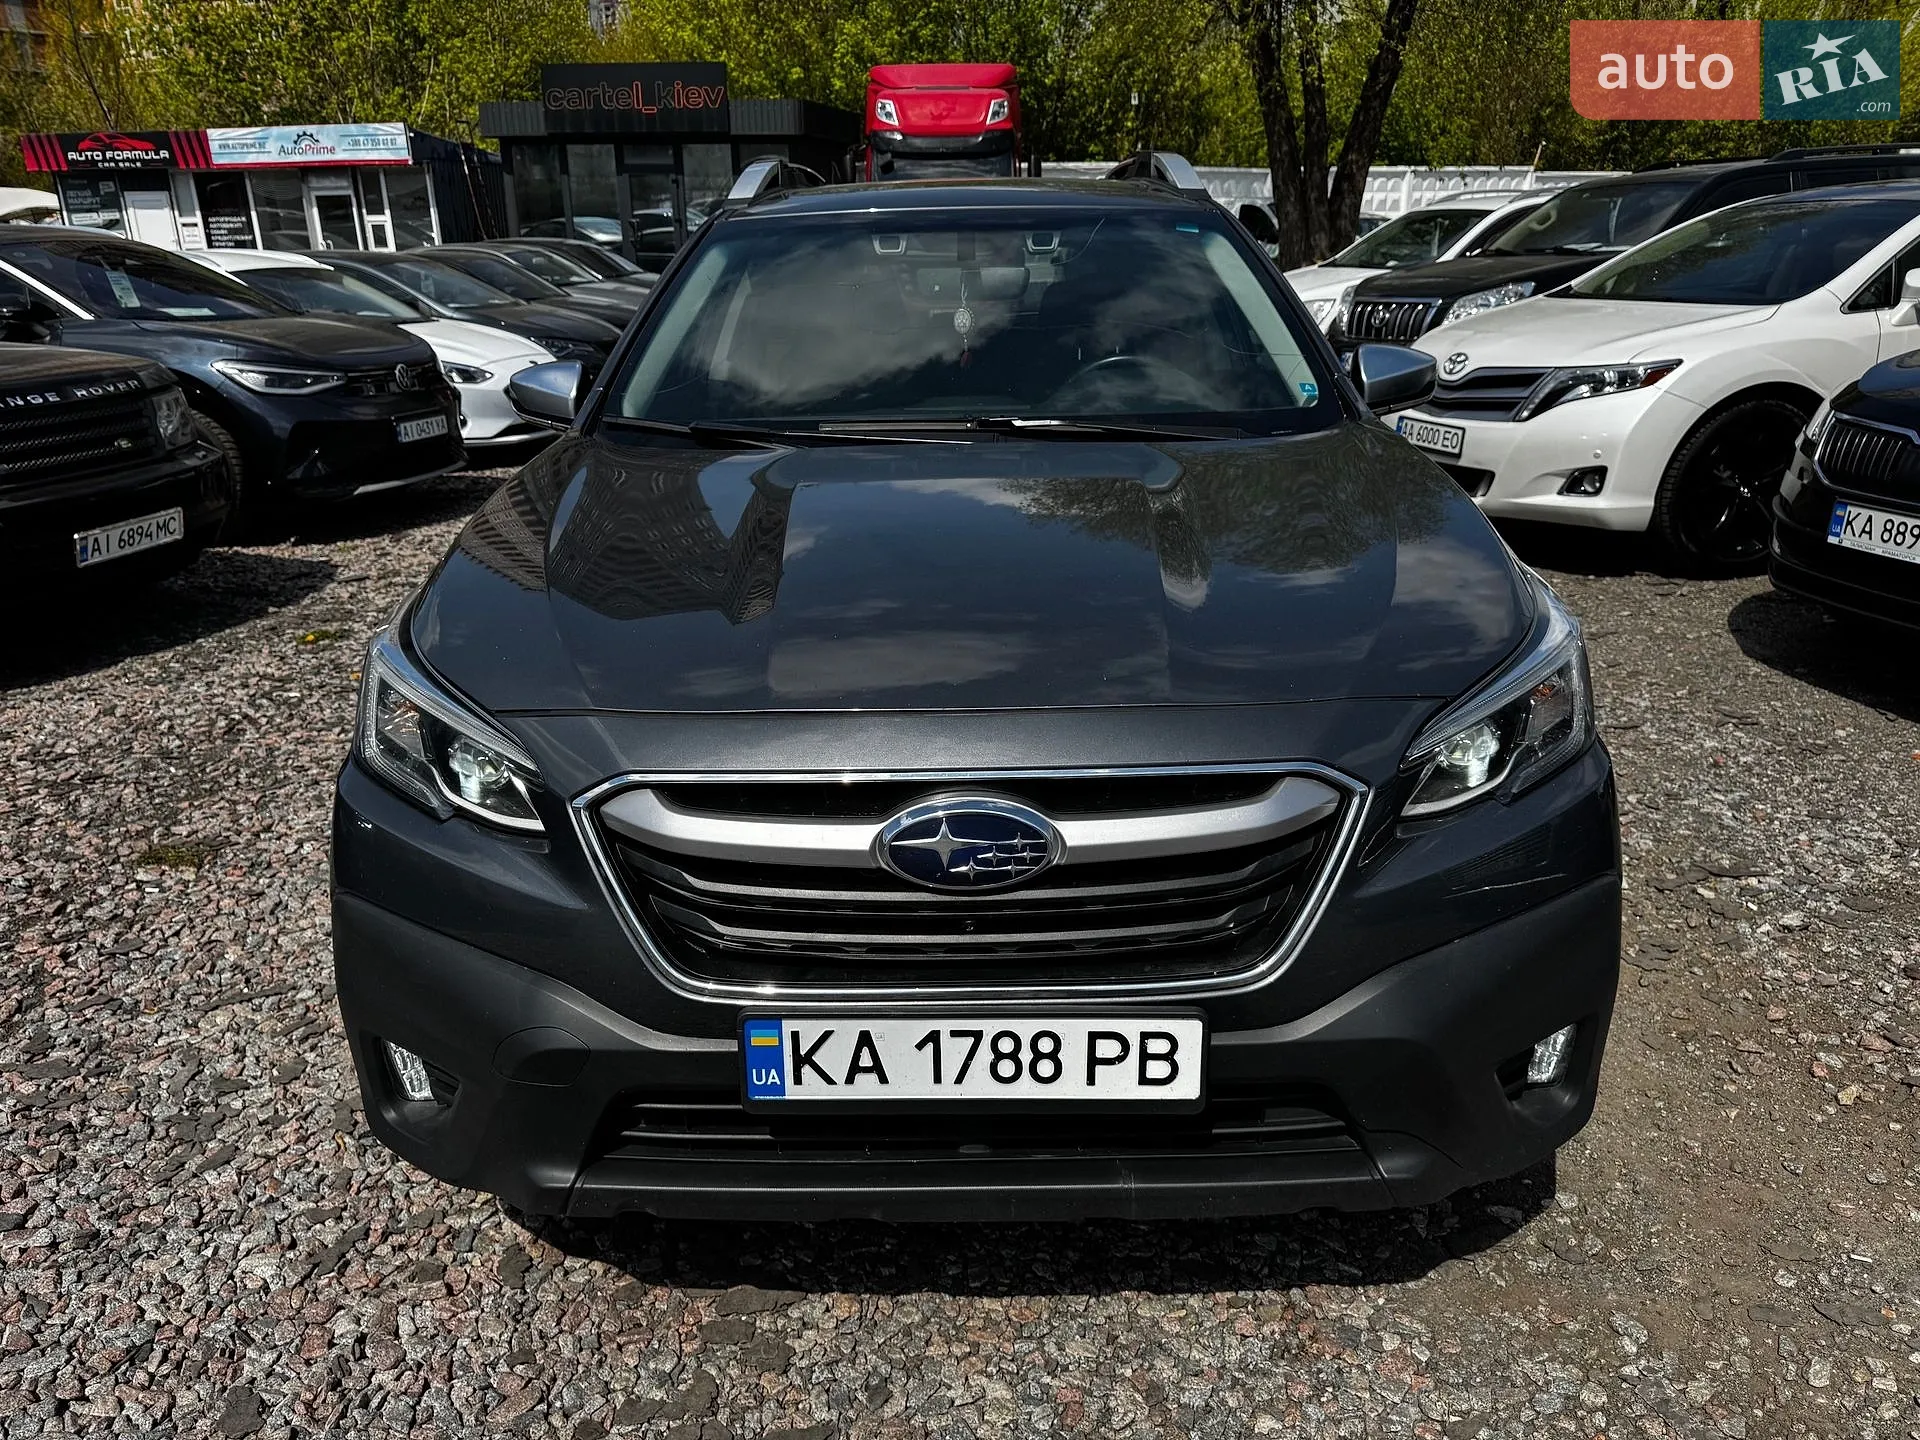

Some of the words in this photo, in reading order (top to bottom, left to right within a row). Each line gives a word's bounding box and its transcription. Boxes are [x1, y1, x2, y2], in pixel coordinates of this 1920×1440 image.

[544, 80, 725, 113] cartel_kiev
[67, 151, 103, 161] AUTO
[105, 150, 169, 160] FORMULA
[278, 143, 335, 156] AutoPrime
[0, 392, 61, 408] NGE
[73, 380, 140, 398] ROVER
[1402, 422, 1413, 441] AA
[1416, 425, 1440, 445] 6000
[1441, 430, 1459, 449] EO
[91, 533, 110, 558] AI
[118, 522, 153, 549] 6894
[156, 517, 176, 539] MC
[1844, 509, 1873, 541] KA
[790, 1030, 890, 1086] KA
[914, 1030, 1063, 1085] 1788
[1086, 1030, 1180, 1086] PB
[752, 1068, 781, 1086] UA
